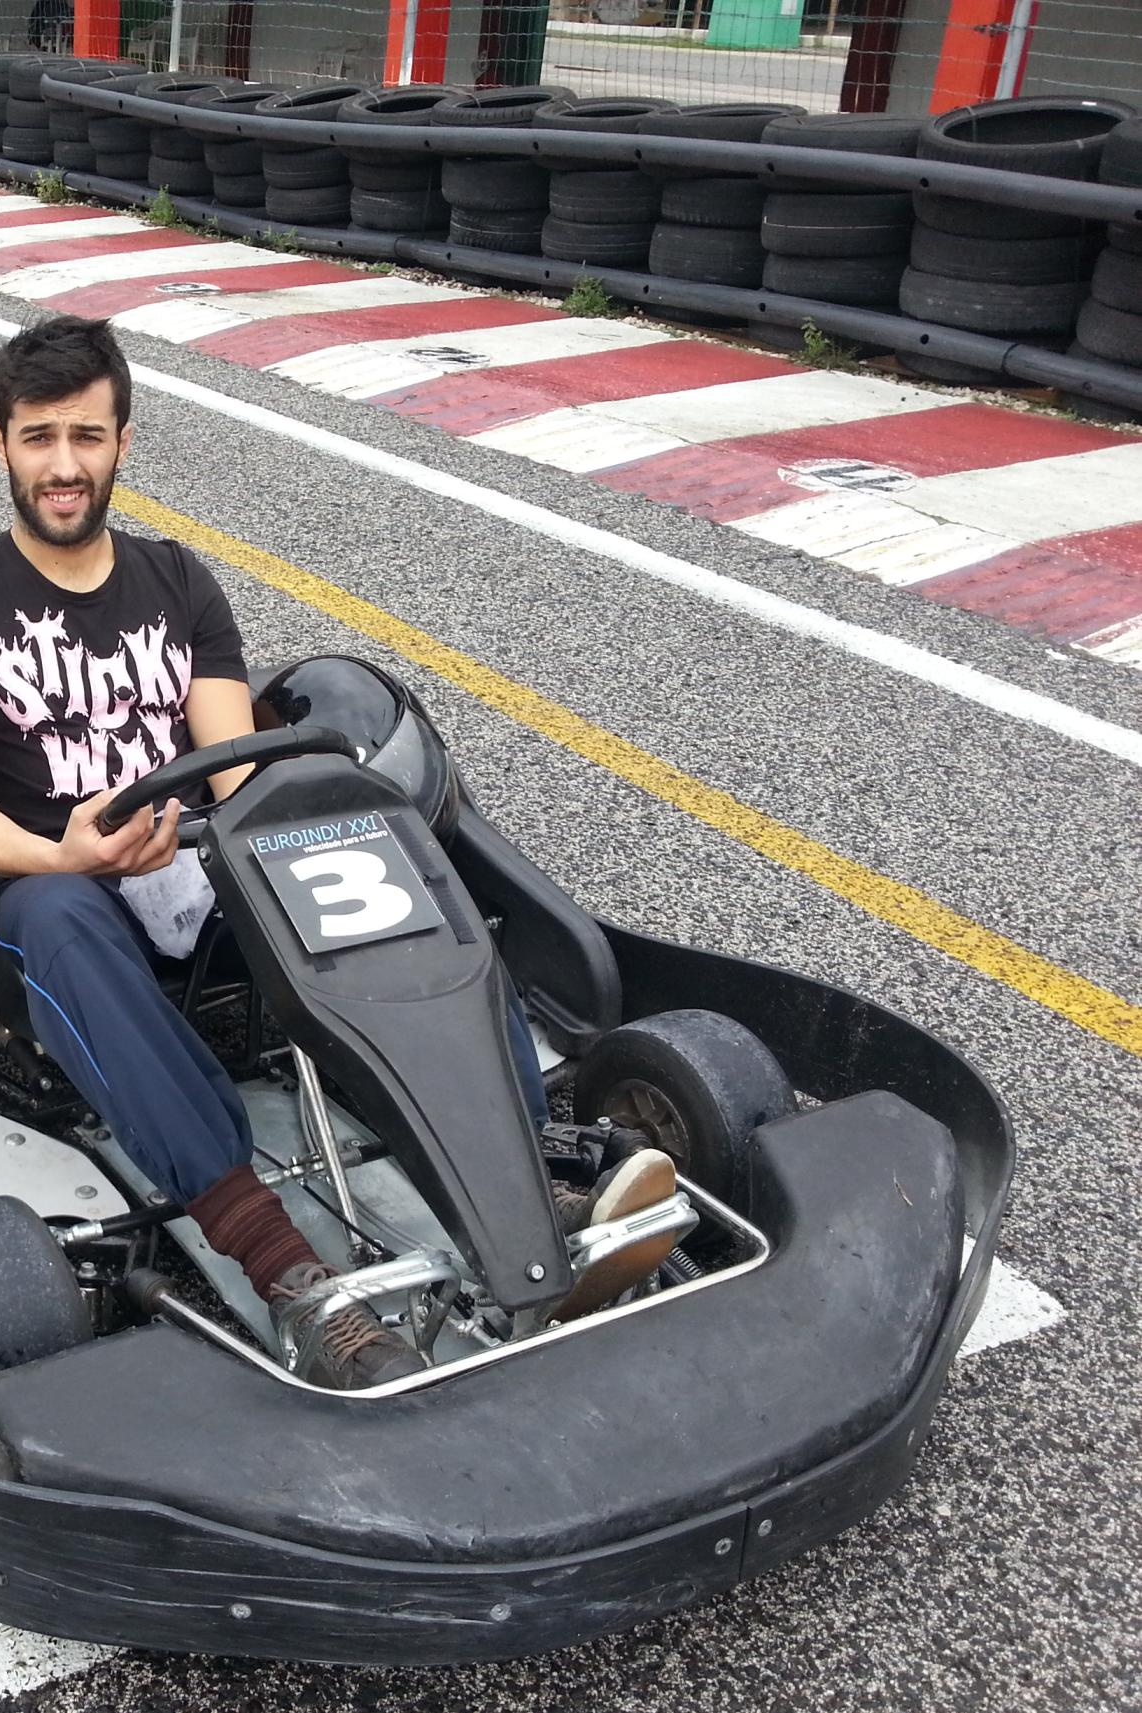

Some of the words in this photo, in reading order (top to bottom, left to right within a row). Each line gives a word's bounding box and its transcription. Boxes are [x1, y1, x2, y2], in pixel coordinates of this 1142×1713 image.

[255, 821, 342, 853] EUROINDY
[346, 814, 378, 835] XXI
[302, 839, 342, 853] velocidade
[342, 835, 360, 847] para
[359, 831, 366, 841] o
[365, 829, 388, 840] futuro
[289, 850, 413, 937] 3
